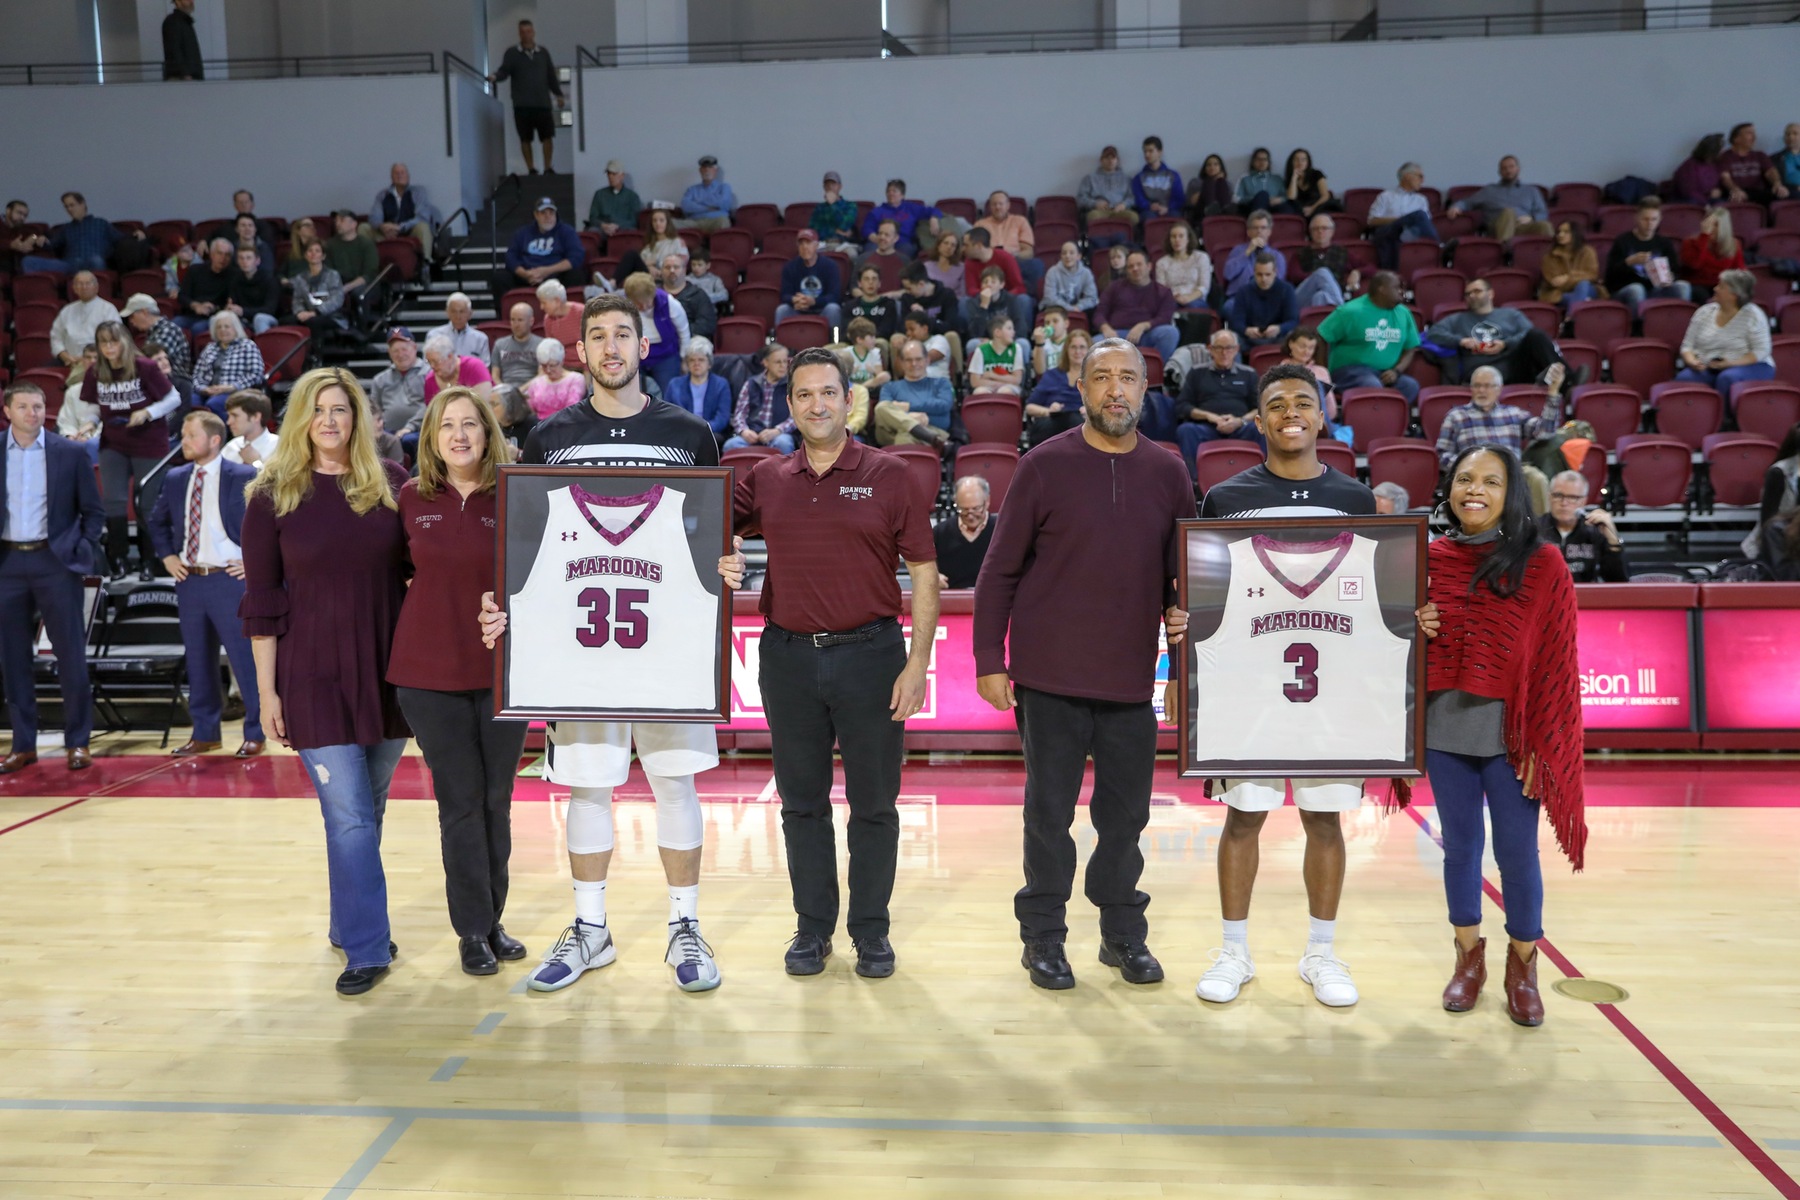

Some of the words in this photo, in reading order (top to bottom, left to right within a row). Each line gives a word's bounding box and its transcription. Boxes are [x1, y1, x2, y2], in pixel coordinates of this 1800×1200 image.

[97, 378, 141, 394] ROANOKE
[839, 486, 873, 497] ROANOKE
[565, 555, 662, 583] MAROONS
[1343, 581, 1358, 591] 175
[127, 591, 179, 607] ROANOKE
[576, 587, 649, 649] 35
[1251, 610, 1353, 637] MAROONS
[1283, 643, 1319, 703] 3
